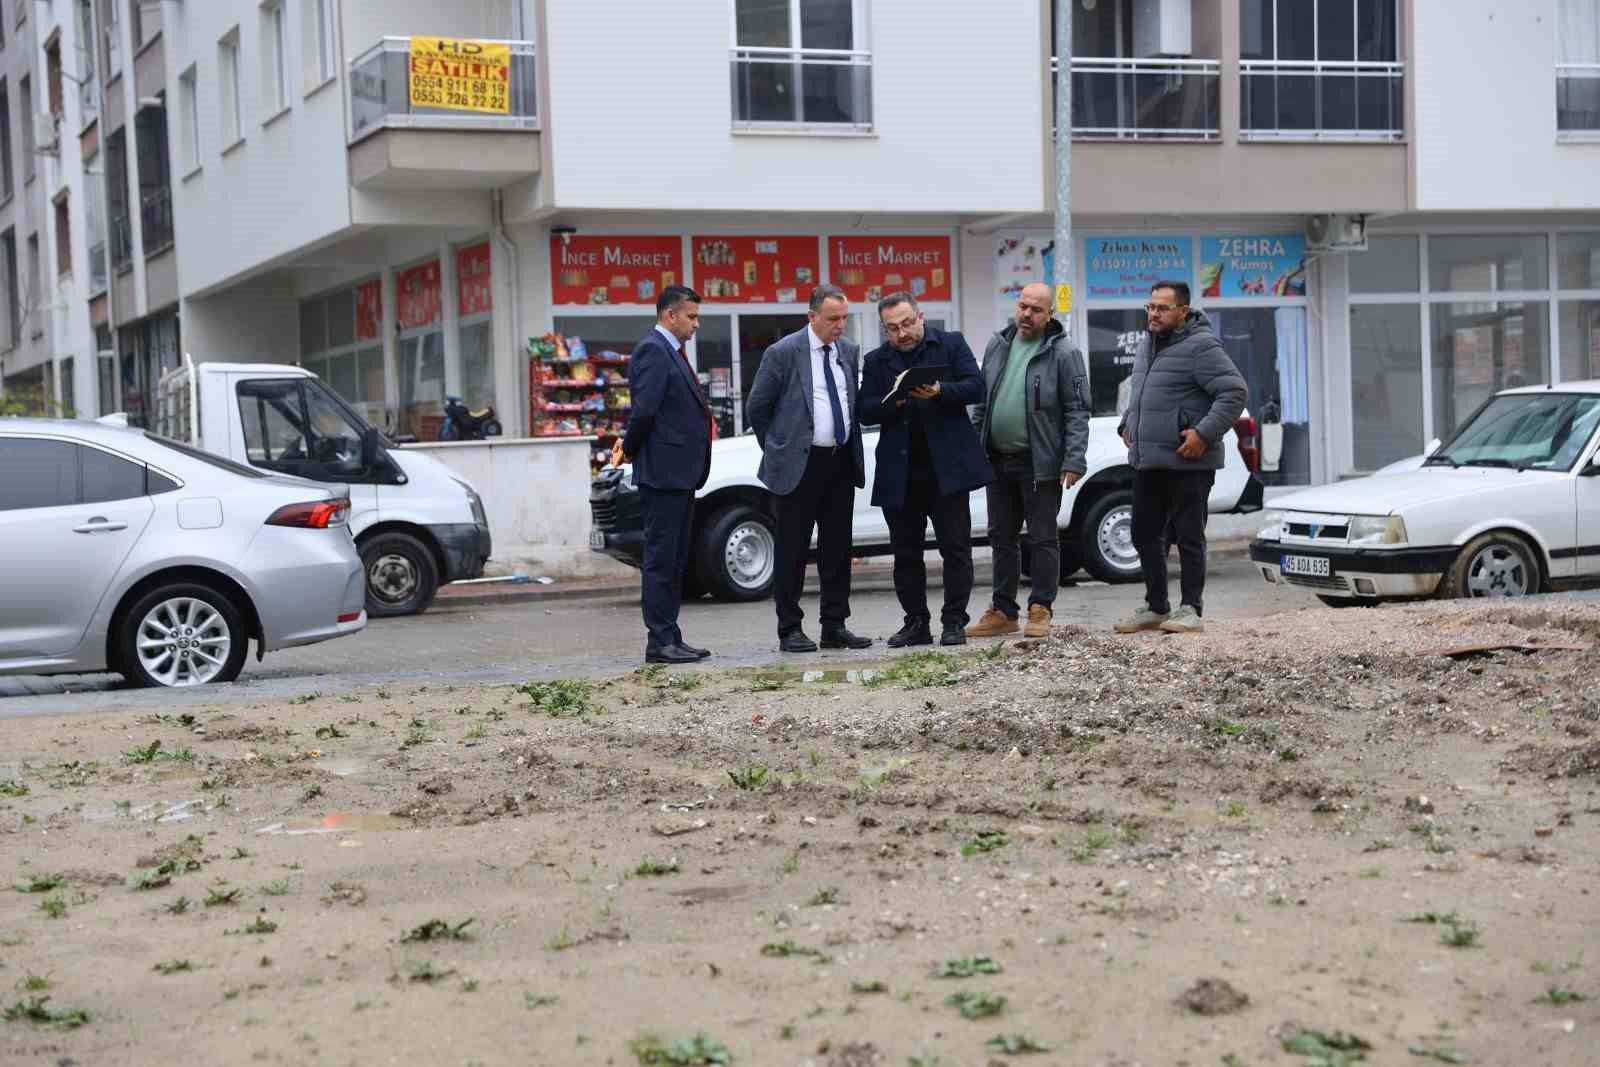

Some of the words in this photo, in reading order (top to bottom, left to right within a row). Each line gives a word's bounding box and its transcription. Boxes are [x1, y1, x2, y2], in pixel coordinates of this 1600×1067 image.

[438, 41, 482, 54] HD
[414, 57, 506, 81] SATILIK
[412, 75, 442, 90] 0554
[447, 78, 468, 92] 911
[412, 89, 442, 104] 0553
[604, 245, 672, 266] MARKET
[878, 245, 941, 265] MARKET
[1218, 238, 1286, 257] ZEHRA
[1116, 330, 1149, 348] ZEH
